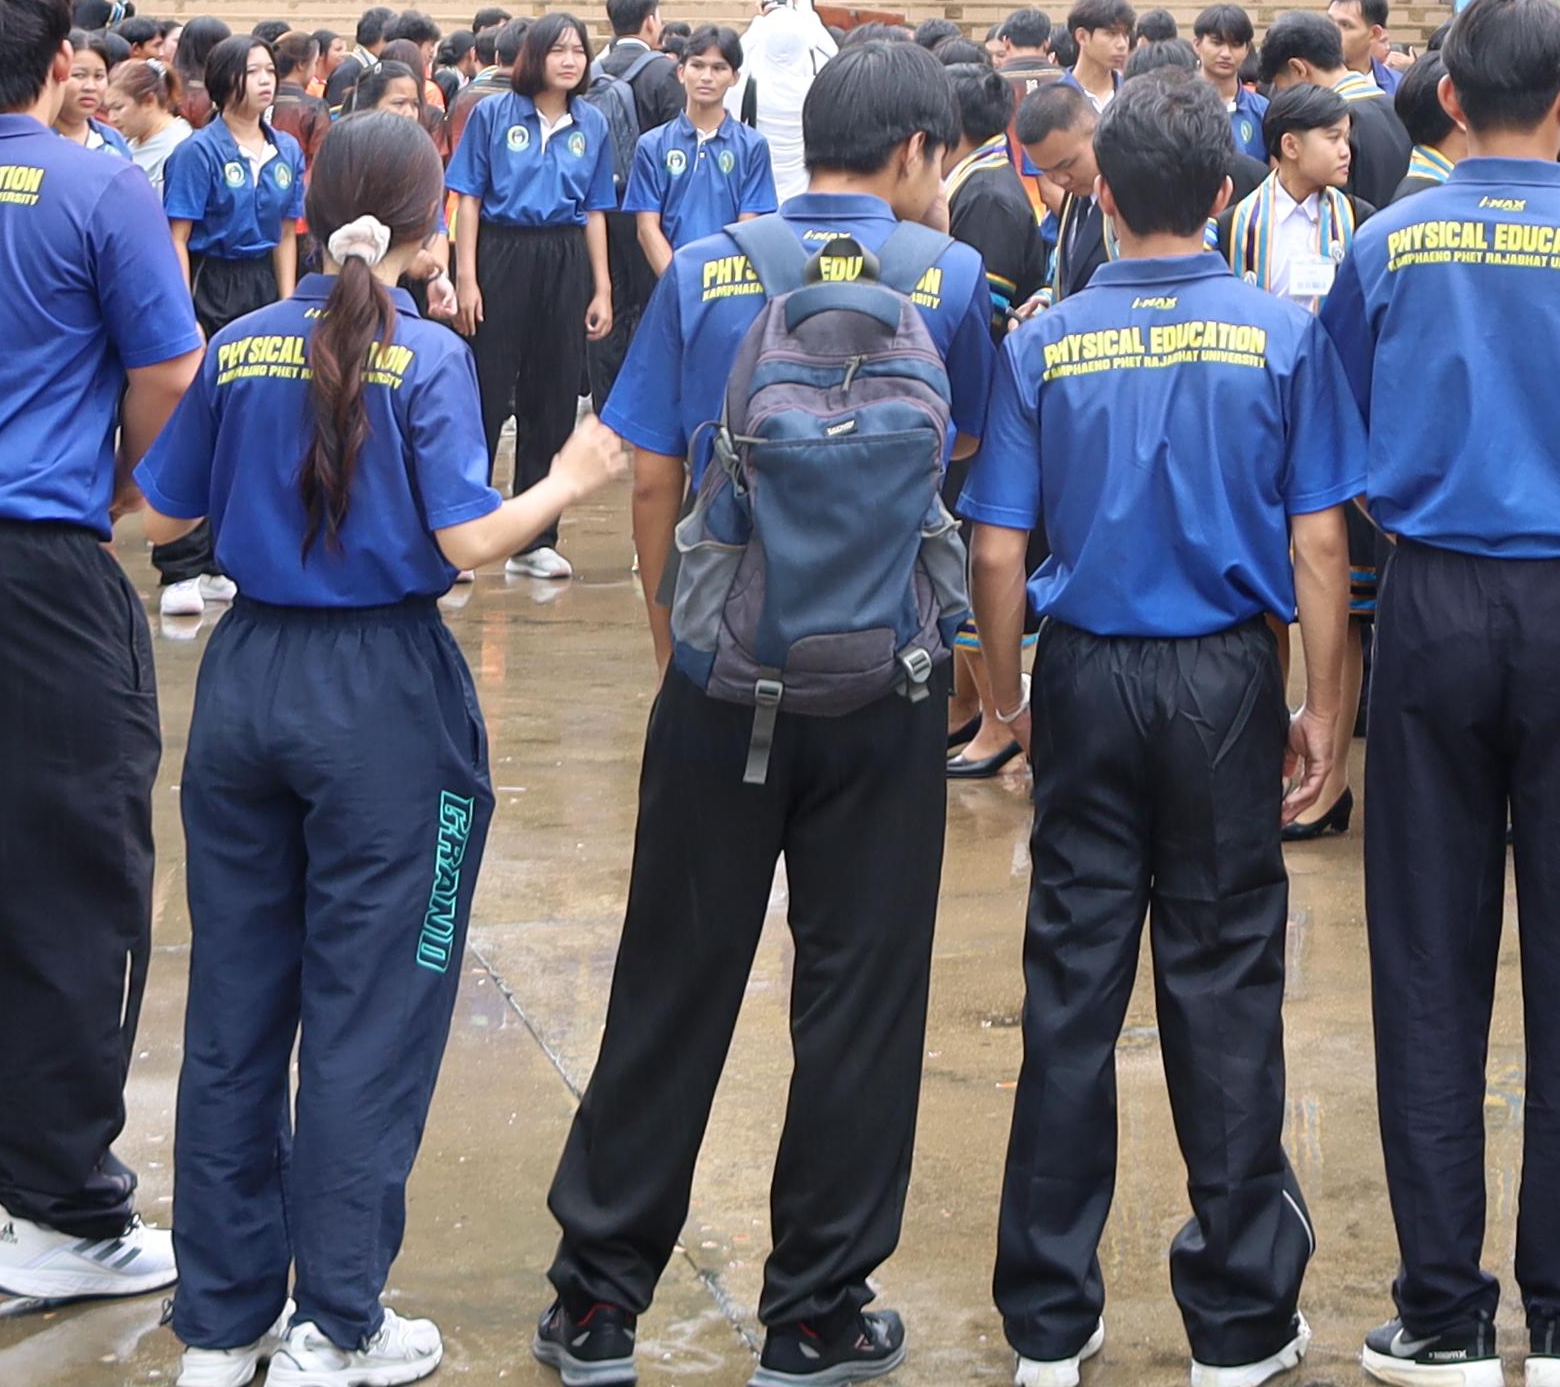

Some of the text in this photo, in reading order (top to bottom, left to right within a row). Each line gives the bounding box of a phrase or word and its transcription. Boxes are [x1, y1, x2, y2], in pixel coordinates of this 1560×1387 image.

[1388, 221, 1488, 259] PHYSICAL
[1454, 251, 1483, 264] PHET
[1486, 252, 1548, 268] RAJABHAT
[218, 335, 306, 372] PHYSICAL
[1043, 321, 1266, 368] PHYSICAL EDUCATION
[1113, 355, 1142, 370] PHET
[1201, 349, 1267, 369] UNIVERSITY
[268, 366, 300, 379] PHET
[415, 789, 475, 973] GRAND
